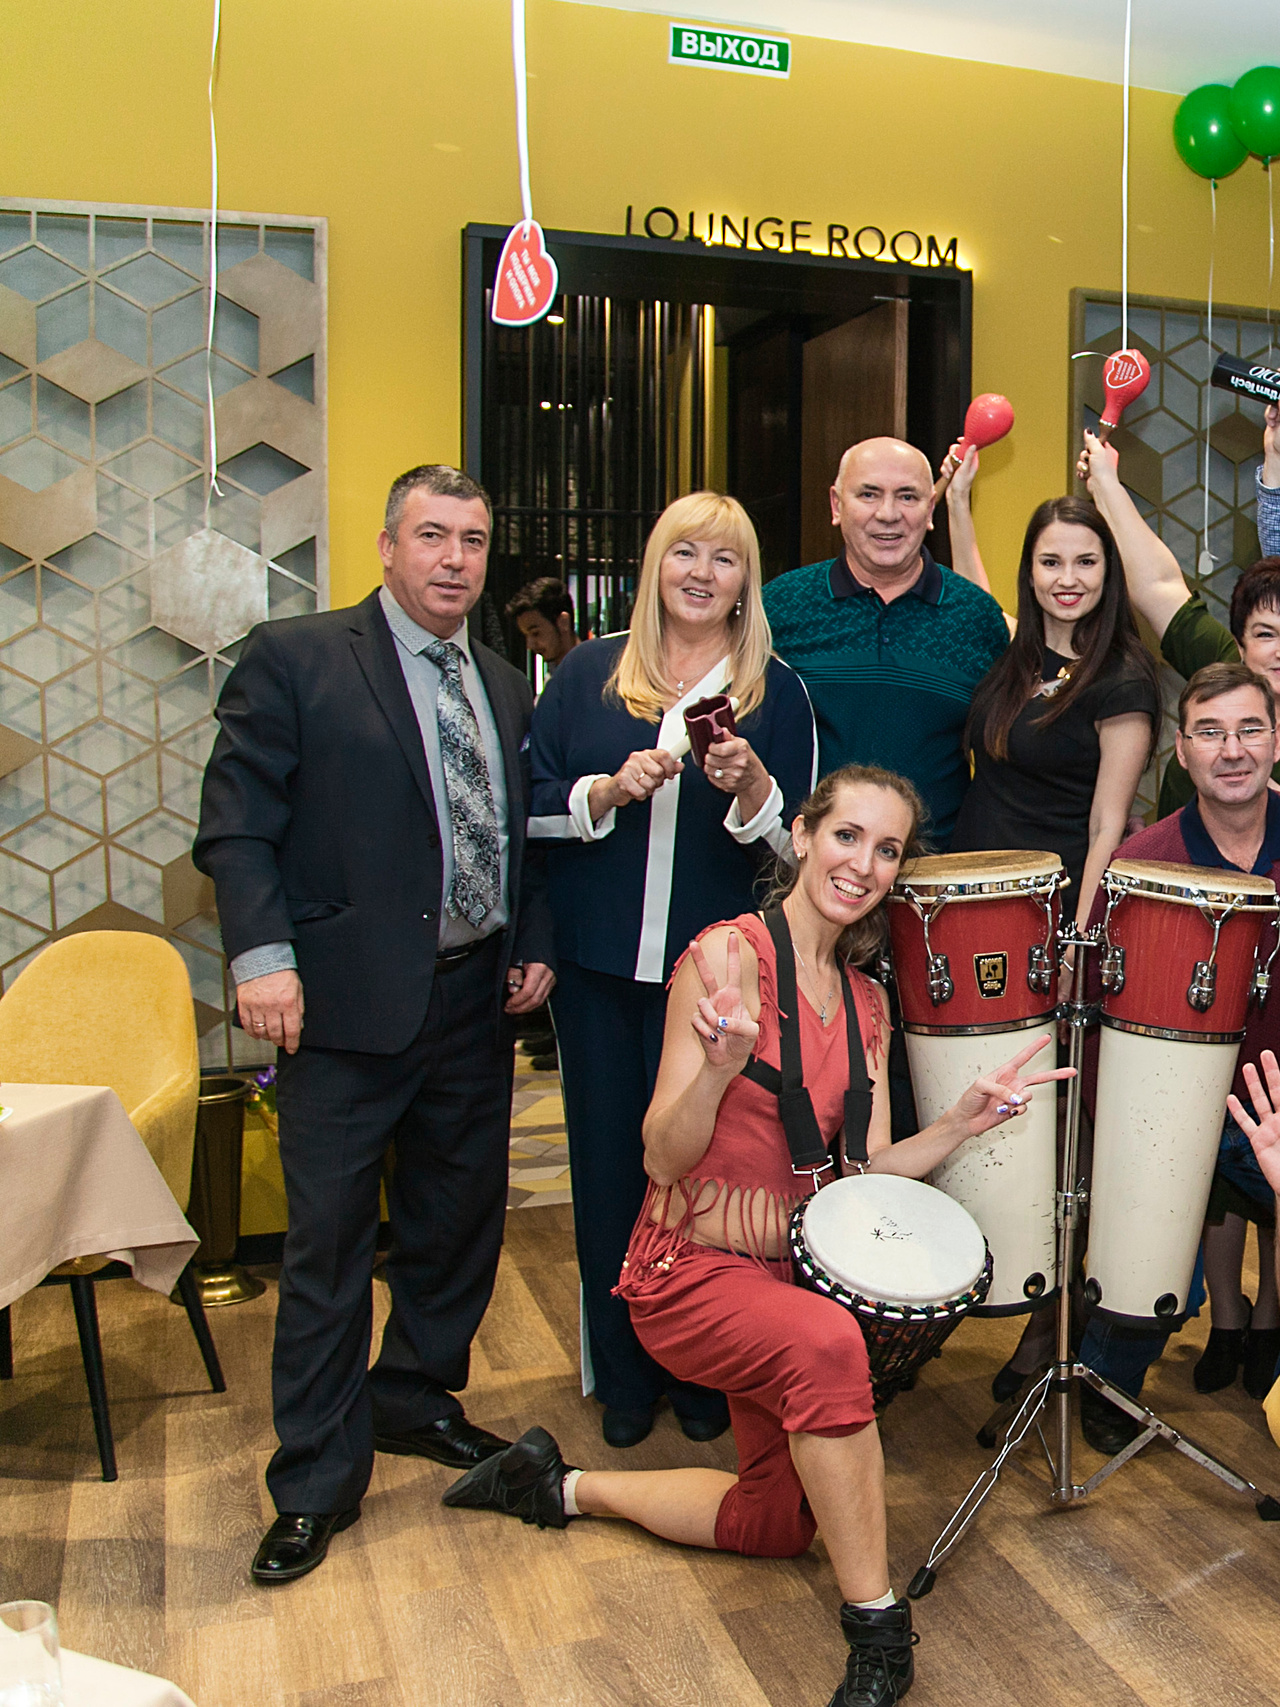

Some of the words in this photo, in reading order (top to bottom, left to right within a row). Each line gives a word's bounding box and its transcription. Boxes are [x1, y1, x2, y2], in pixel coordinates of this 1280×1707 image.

[681, 31, 780, 68] ВЫХОД
[626, 205, 812, 250] LOUNGE
[827, 223, 958, 267] ROOM
[520, 248, 531, 265] ТЫ
[527, 263, 541, 287] МОЯ
